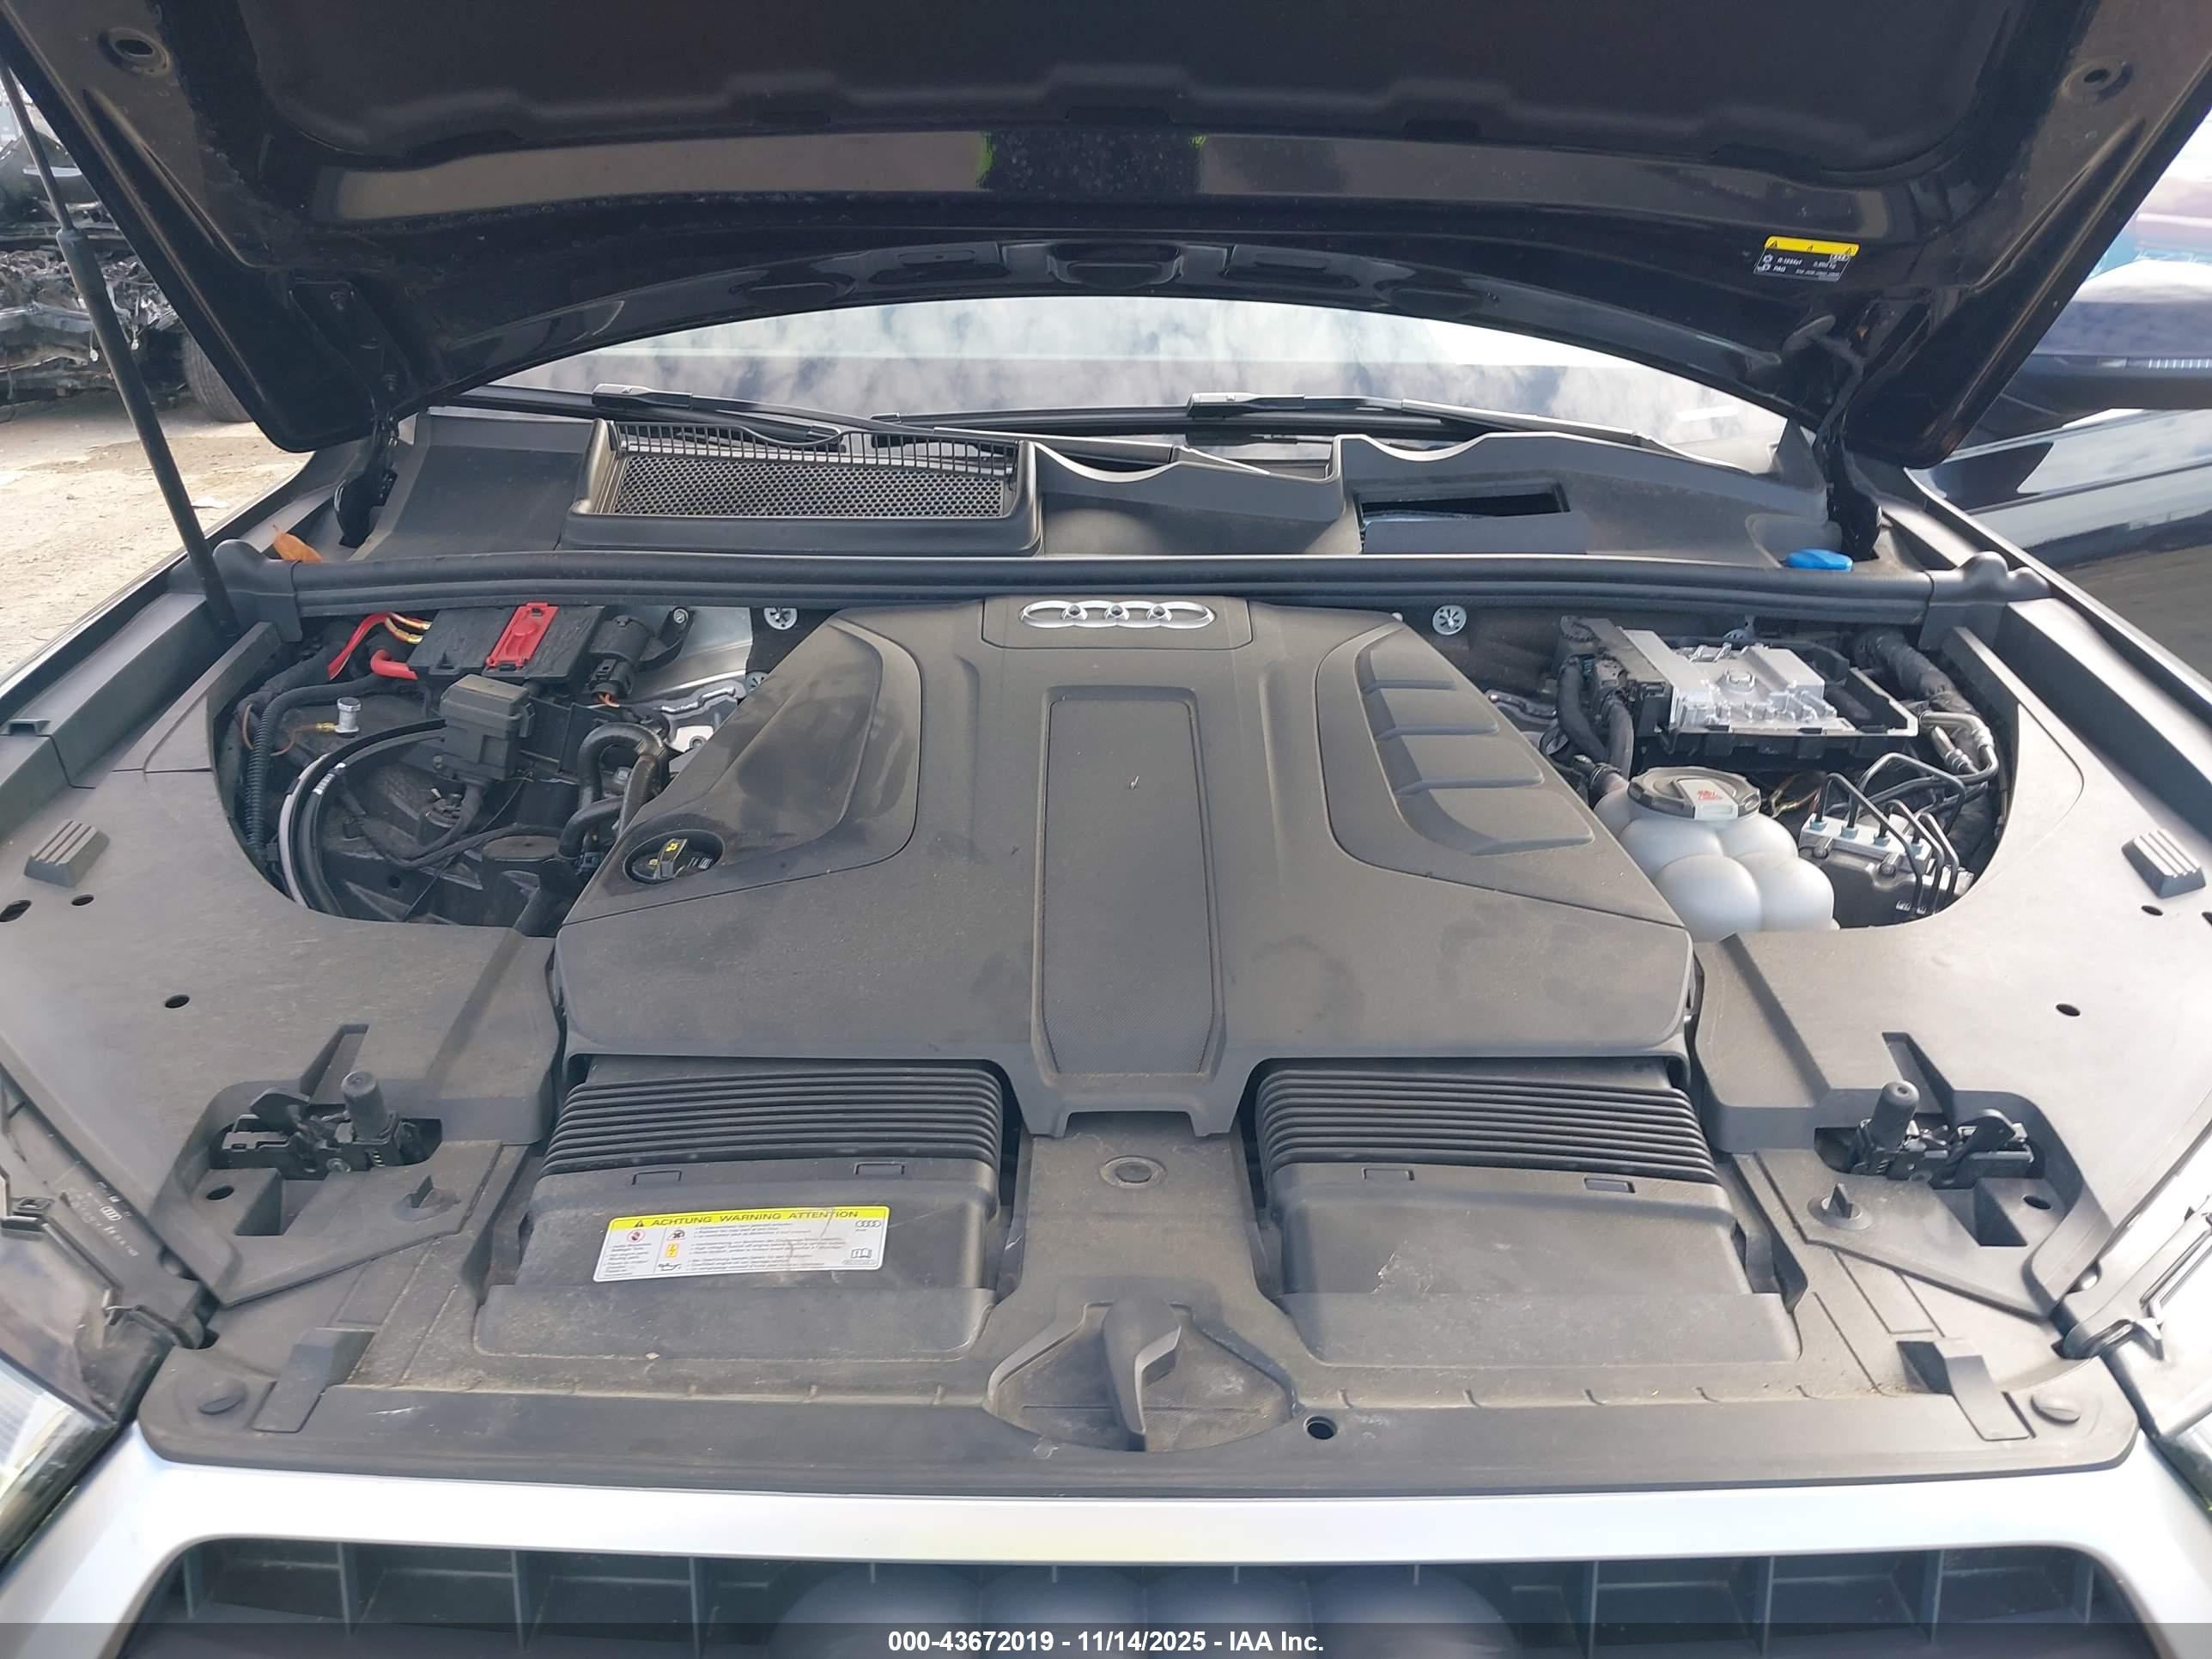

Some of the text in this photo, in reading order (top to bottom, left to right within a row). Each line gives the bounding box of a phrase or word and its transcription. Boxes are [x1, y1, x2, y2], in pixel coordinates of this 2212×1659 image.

[651, 1211, 859, 1226] ACHTUNG WARNING ATTENTION
